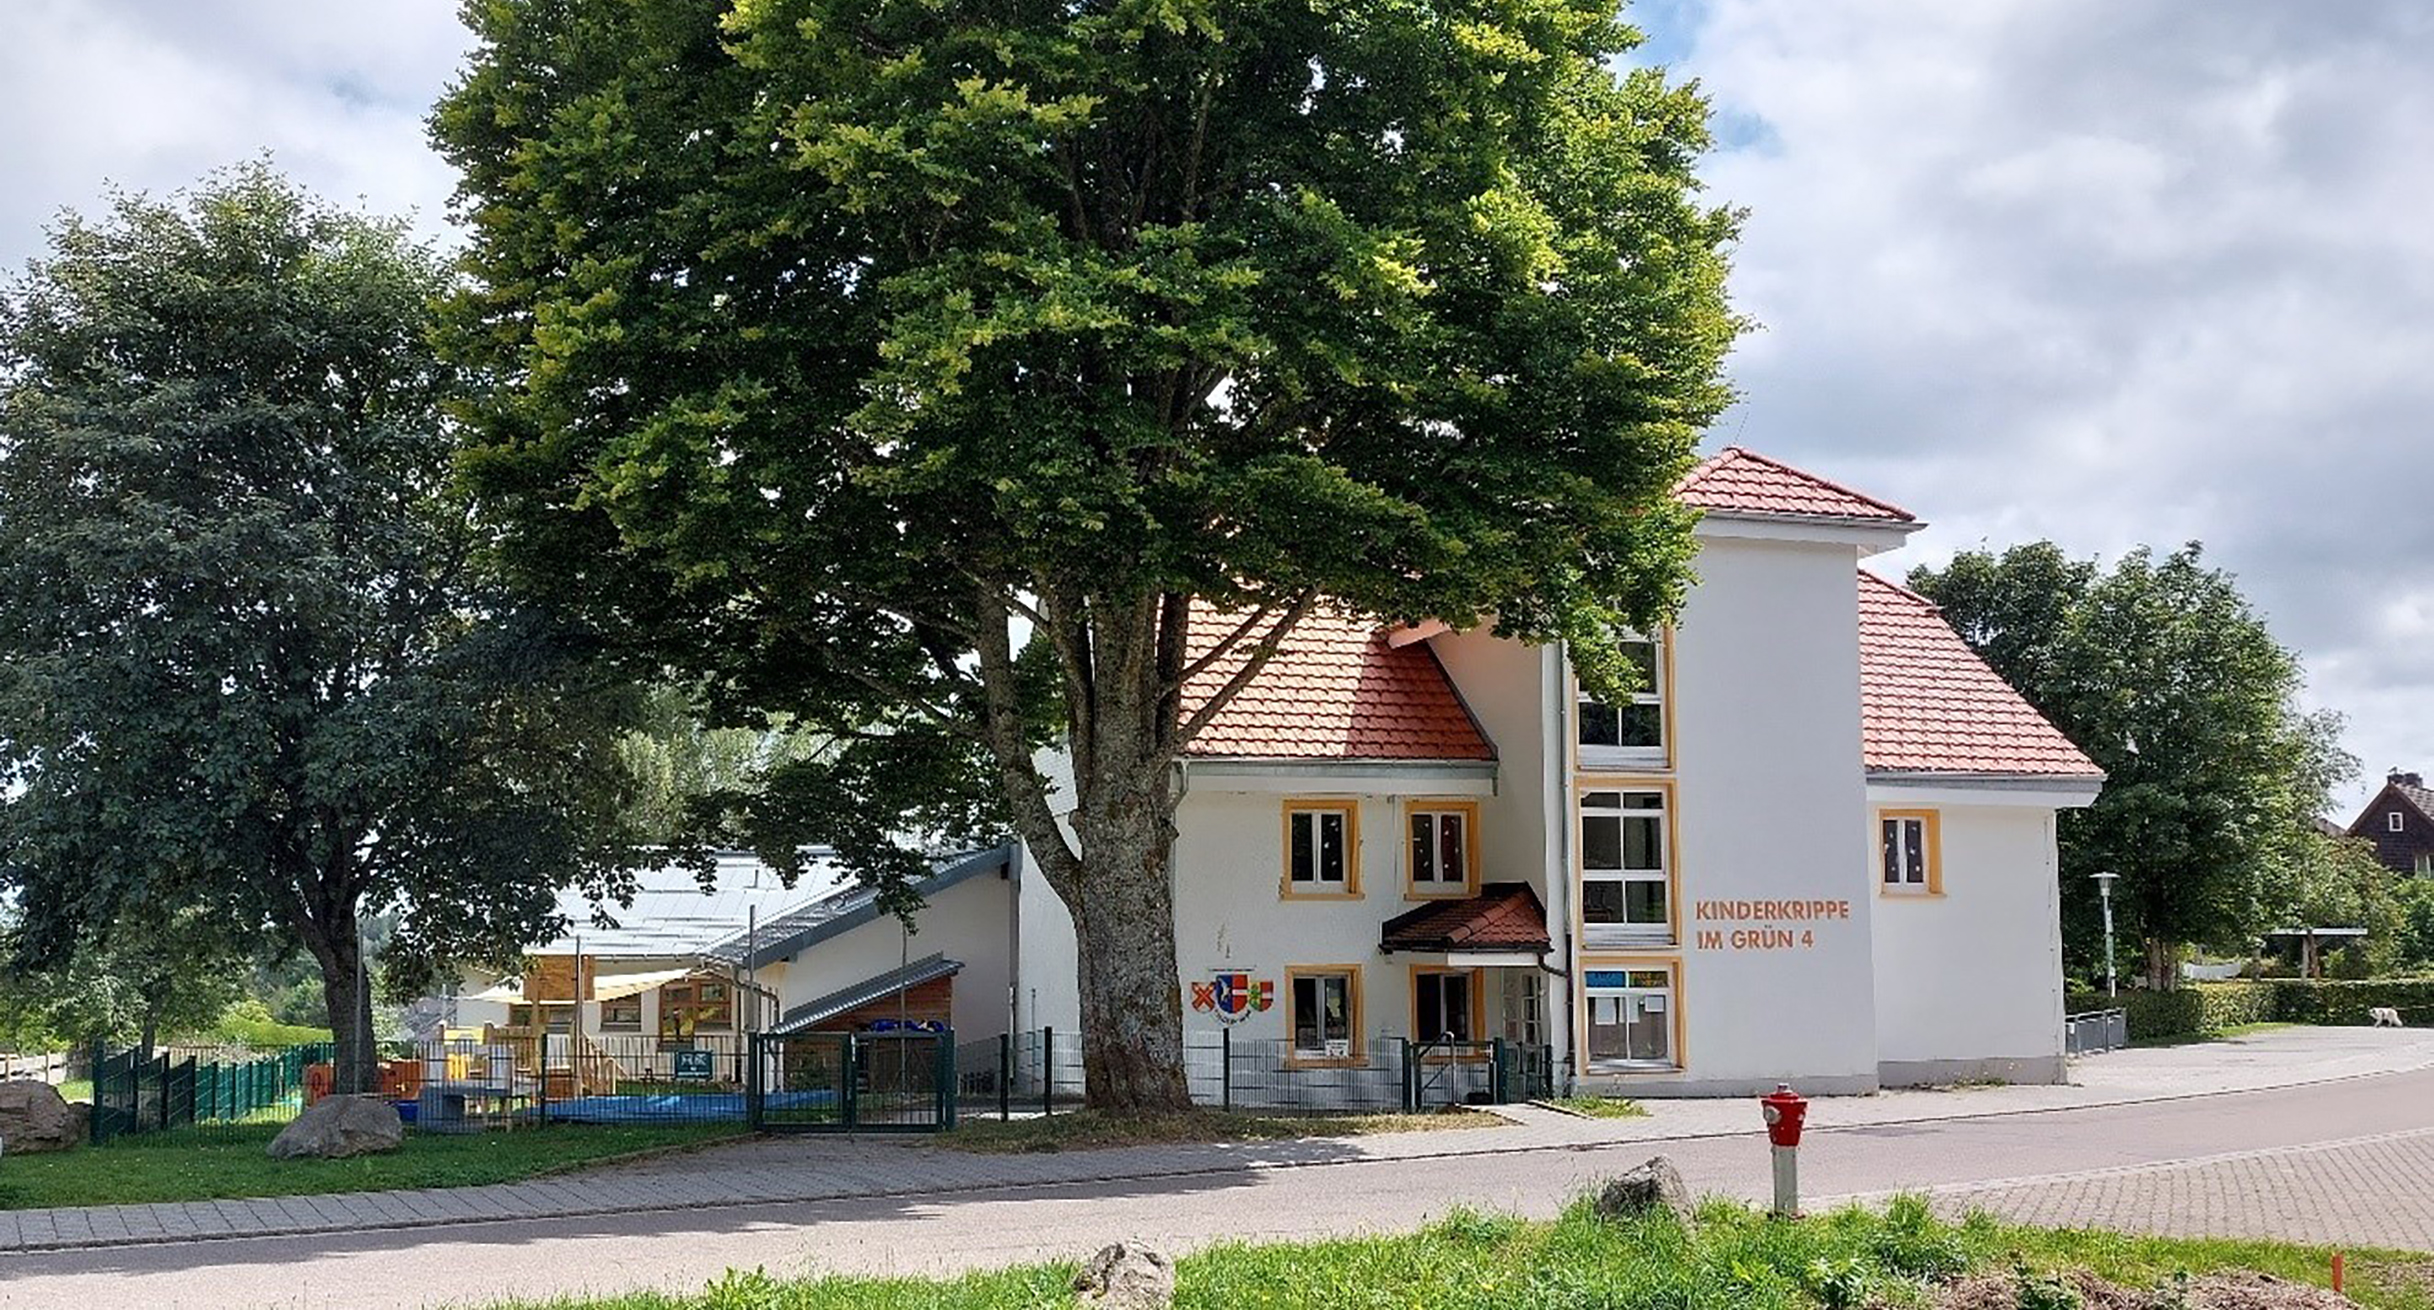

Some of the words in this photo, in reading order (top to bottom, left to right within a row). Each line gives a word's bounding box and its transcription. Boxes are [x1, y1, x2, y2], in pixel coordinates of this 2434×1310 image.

[1696, 901, 1849, 920] KINDERKRIPPE
[1697, 931, 1723, 949] IM
[1731, 924, 1793, 949] GRÜN
[1801, 930, 1814, 948] 4
